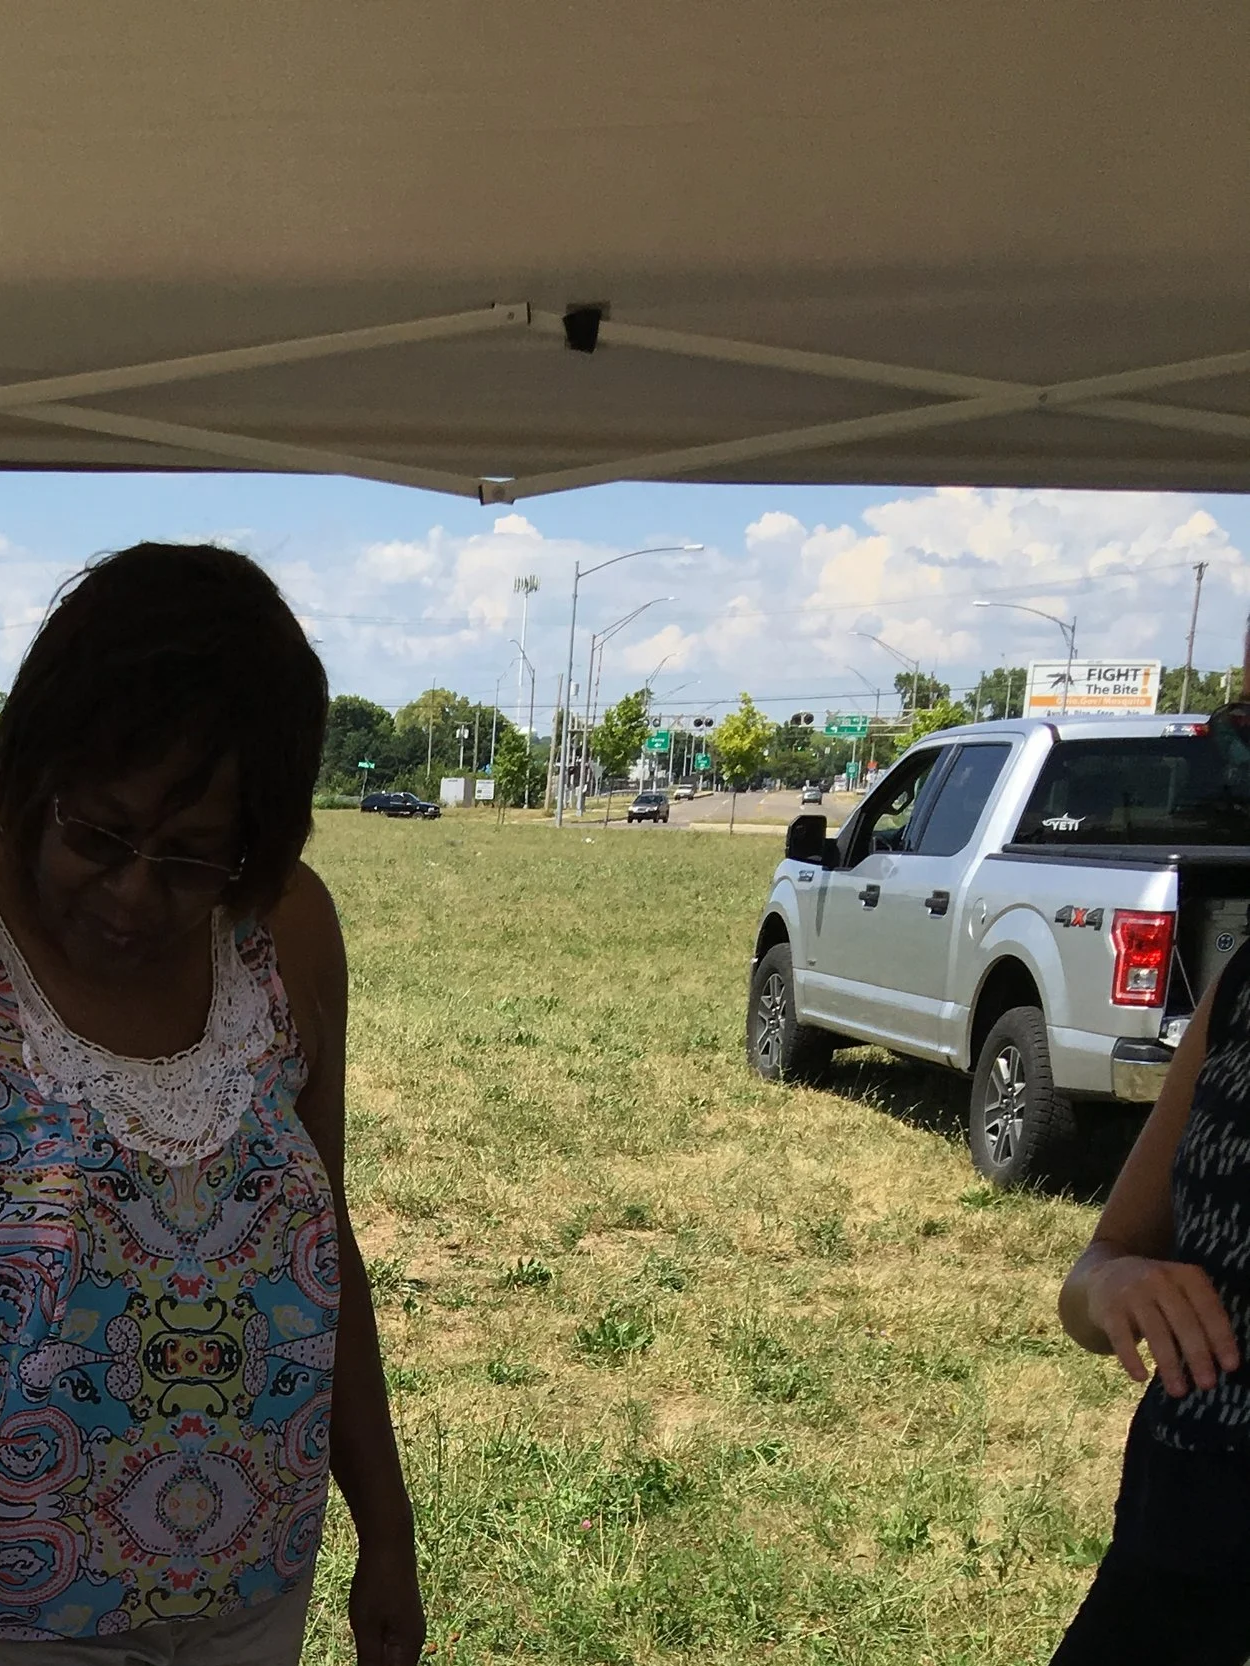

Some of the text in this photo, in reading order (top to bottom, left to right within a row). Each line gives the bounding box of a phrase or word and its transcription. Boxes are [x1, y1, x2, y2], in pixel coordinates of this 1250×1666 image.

[1086, 668, 1141, 682] FIGHT
[1086, 684, 1139, 695] The Bite
[1050, 819, 1079, 831] YETI
